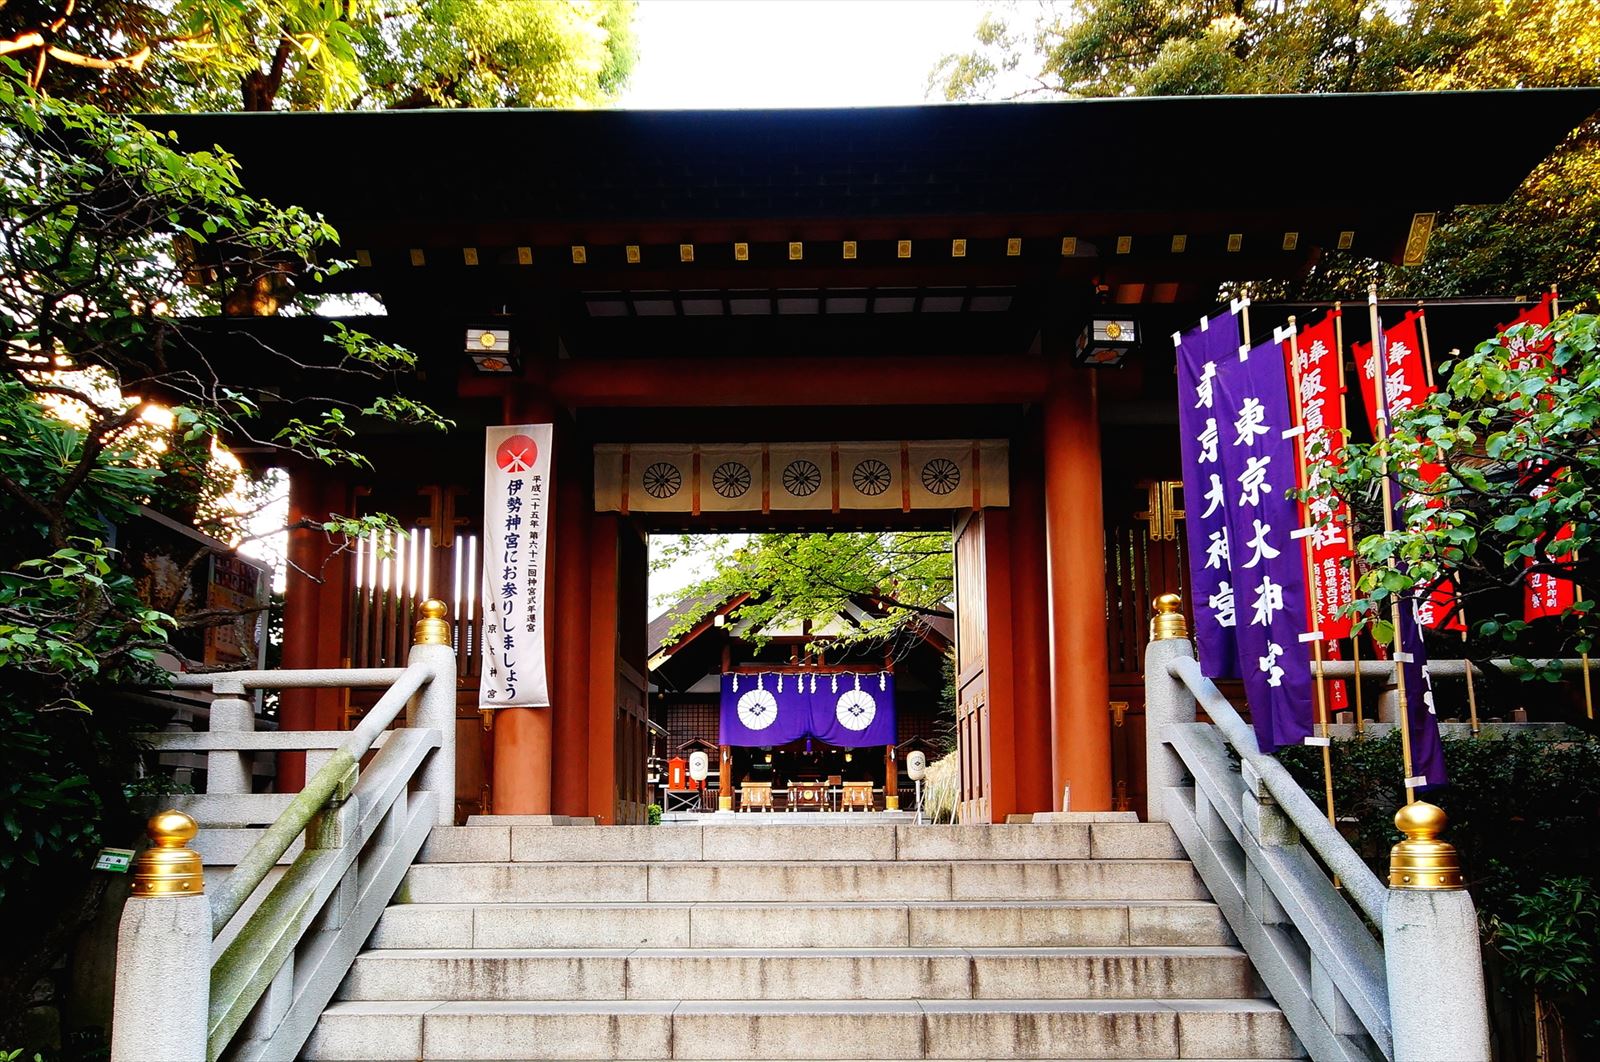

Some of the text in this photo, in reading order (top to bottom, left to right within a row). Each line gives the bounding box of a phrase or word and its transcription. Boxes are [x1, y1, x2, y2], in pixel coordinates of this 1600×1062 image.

[530, 475, 542, 528] 平成二十五年
[1232, 396, 1285, 688] 東京大神宮
[487, 601, 498, 699] 東京大神宮
[501, 478, 524, 700] 伊勢神宮にお参りしましょう
